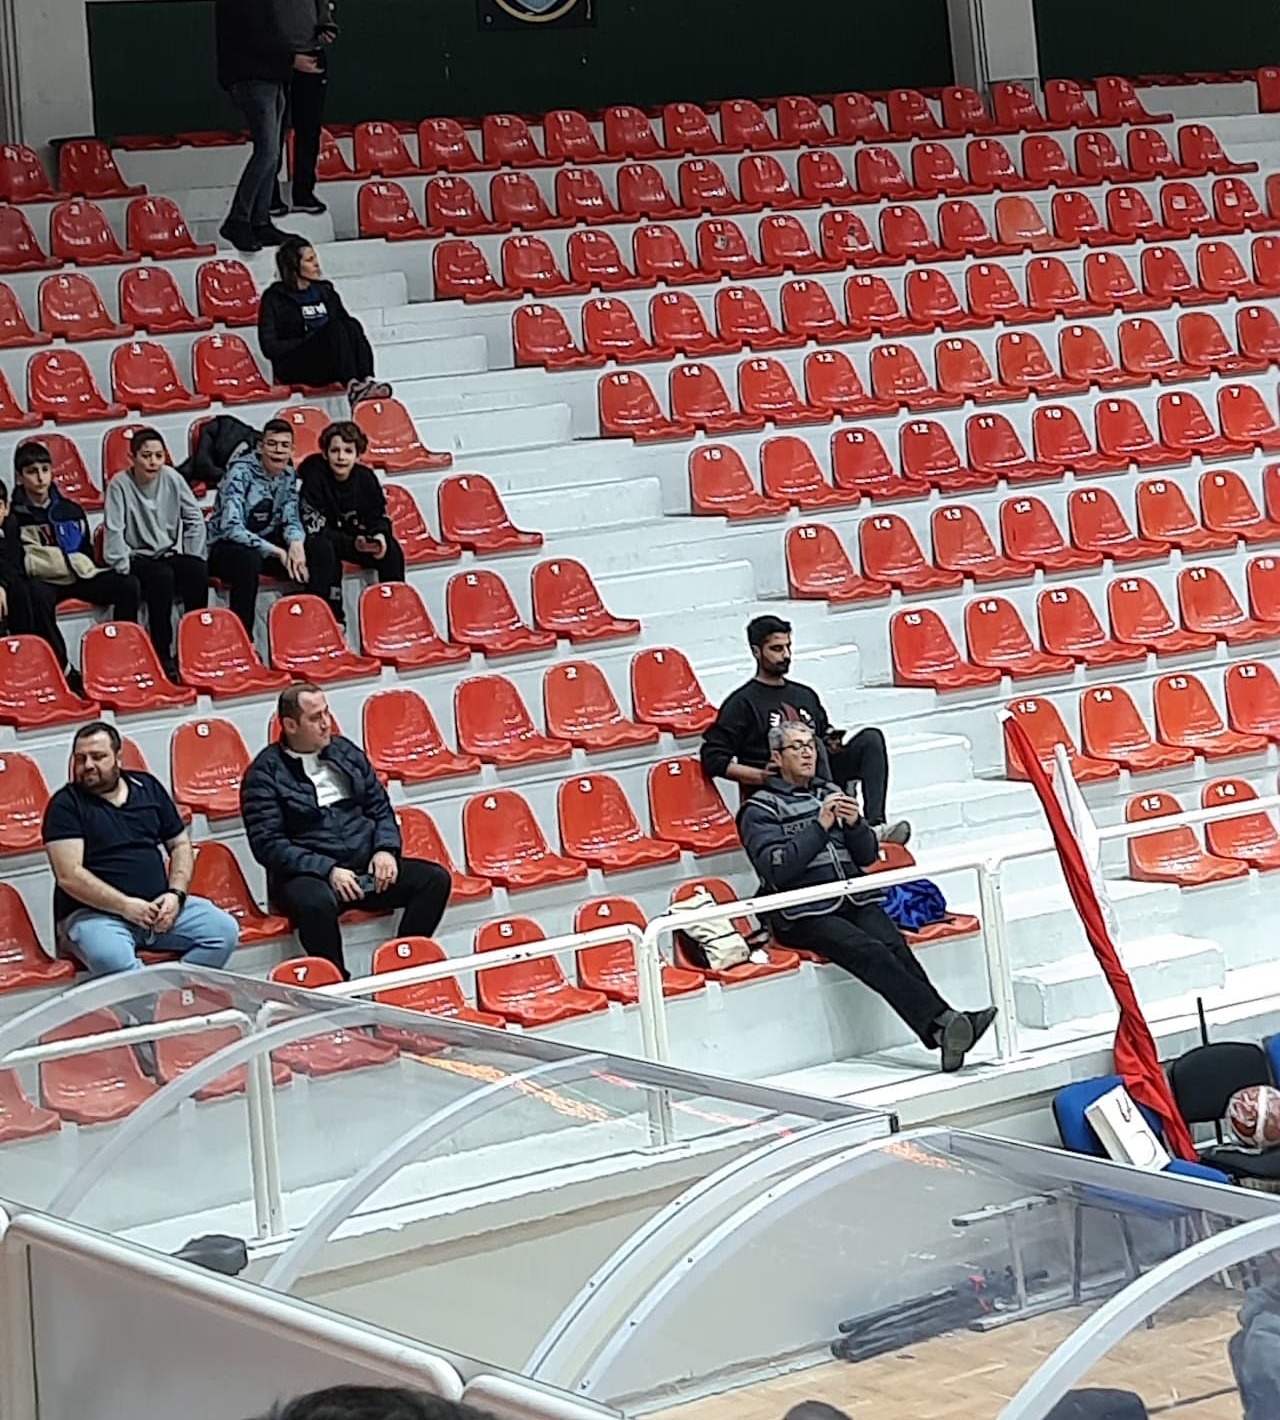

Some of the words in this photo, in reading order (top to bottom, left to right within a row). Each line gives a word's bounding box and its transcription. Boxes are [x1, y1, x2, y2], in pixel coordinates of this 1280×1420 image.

[792, 282, 806, 291] 11
[595, 300, 612, 310] 14
[946, 340, 962, 350] 10
[816, 352, 835, 363] 12
[881, 346, 897, 357] 11
[683, 366, 700, 376] 14
[751, 360, 769, 371] 13
[373, 402, 382, 414] 1
[1045, 409, 1062, 419] 10
[911, 423, 929, 434] 12
[978, 417, 994, 428] 11
[703, 449, 722, 460] 15
[459, 478, 469, 490] 1
[1149, 482, 1165, 494] 10
[1081, 491, 1096, 502] 11
[1014, 501, 1031, 513] 12
[943, 508, 962, 520] 13
[874, 518, 892, 529] 14
[798, 527, 817, 539] 15
[1257, 558, 1275, 569] 10
[1190, 568, 1207, 580] 11
[1120, 580, 1139, 592] 12
[1051, 591, 1068, 603] 13
[290, 603, 302, 615] 4
[979, 601, 997, 613] 14
[201, 612, 213, 625] 5
[104, 625, 117, 637] 6
[7, 640, 20, 653] 7
[654, 651, 663, 663] 1
[565, 667, 578, 679] 2
[1238, 665, 1257, 677] 12
[1168, 677, 1188, 689] 13
[1093, 690, 1113, 702] 14
[1018, 701, 1037, 713] 15
[668, 762, 681, 775] 2
[580, 779, 592, 792] 3
[1215, 784, 1235, 797] 14
[484, 797, 497, 809] 4
[1141, 796, 1161, 811] 15
[597, 904, 611, 916] 4
[500, 923, 513, 937] 5
[397, 943, 411, 957] 6
[293, 966, 308, 981] 7
